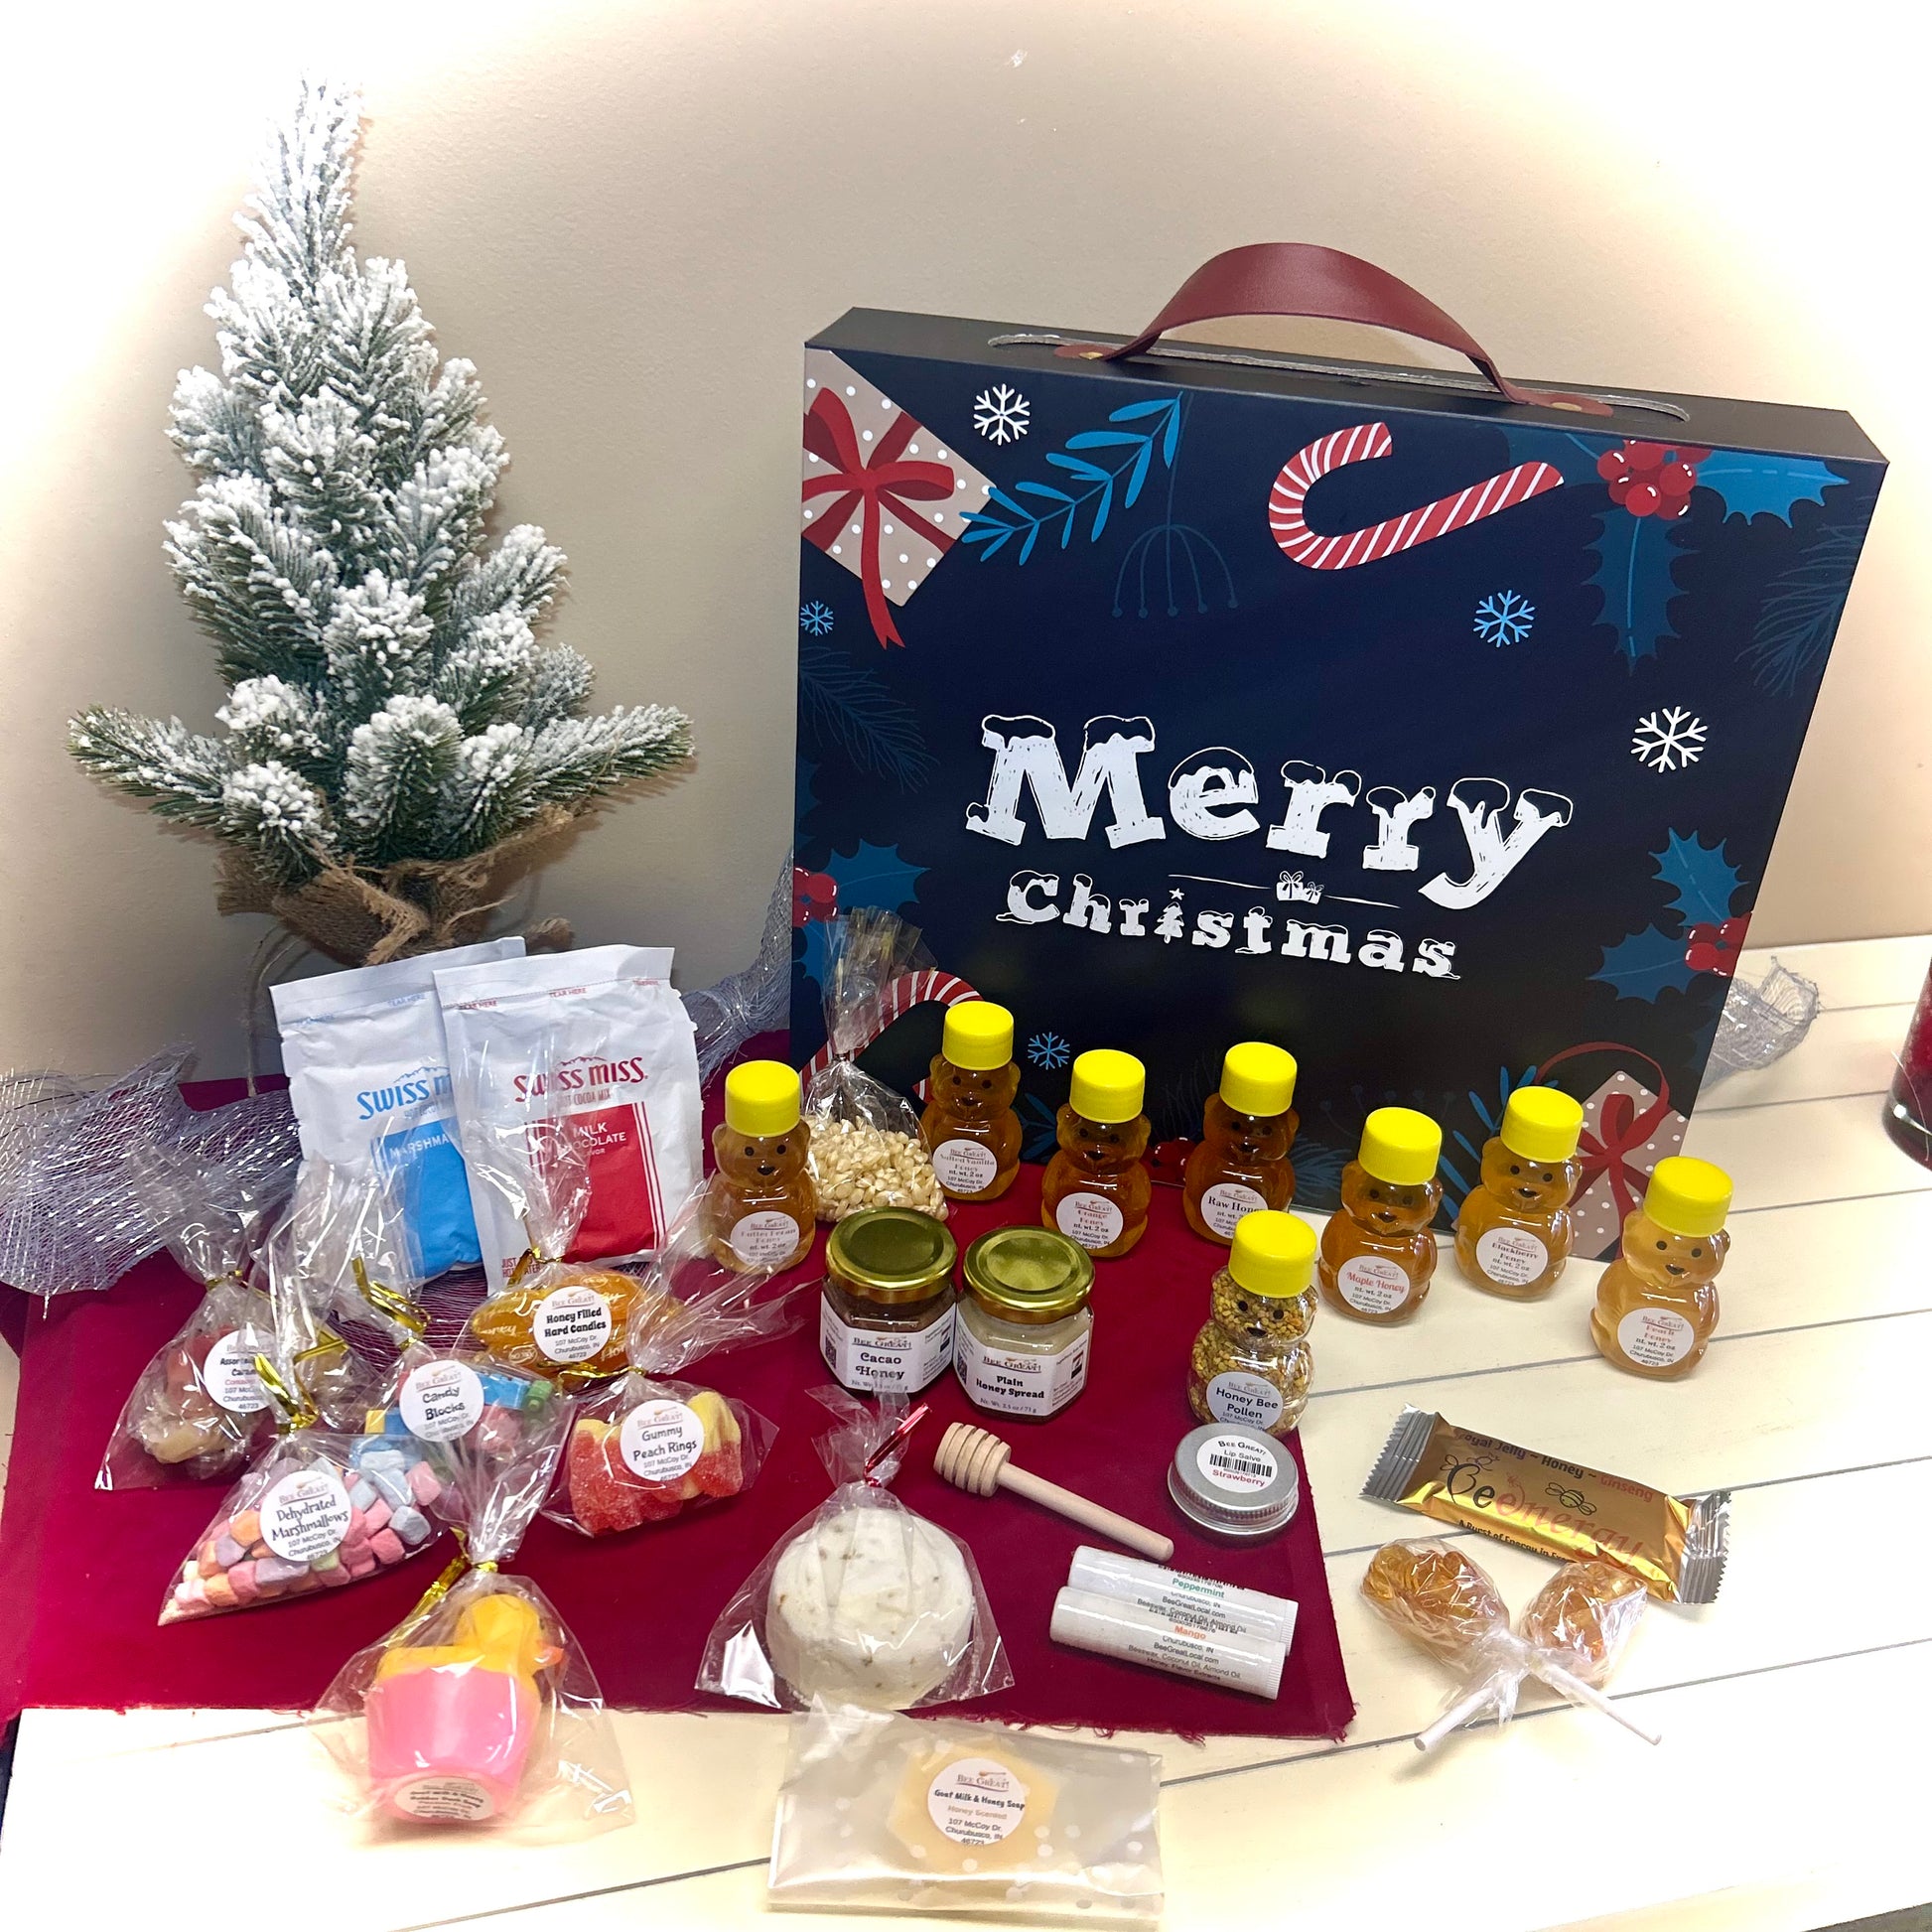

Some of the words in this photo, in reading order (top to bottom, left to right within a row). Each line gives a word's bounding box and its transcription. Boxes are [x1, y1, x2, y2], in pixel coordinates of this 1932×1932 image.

[966, 714, 1574, 910] Merry
[995, 870, 1460, 980] Christmas
[356, 1079, 431, 1120] SWISS
[573, 1122, 608, 1139] MILK
[388, 1133, 450, 1159] MARSHMA
[1207, 1195, 1230, 1208] Raw
[1346, 1271, 1375, 1287] Maple
[1375, 1279, 1406, 1294] Honey
[546, 1312, 576, 1324] Honey
[577, 1307, 602, 1319] Filled
[544, 1325, 569, 1337] Hard
[570, 1320, 607, 1333] Candies
[860, 1351, 902, 1365] Cacao
[855, 1365, 905, 1381] Honey
[996, 1375, 1024, 1387] Plain
[422, 1386, 461, 1404] Candy
[976, 1377, 1007, 1396] Honey
[1008, 1387, 1045, 1399] Spread
[1215, 1387, 1253, 1406] Honey
[1256, 1398, 1279, 1409] Bee
[425, 1402, 466, 1421] Blocks
[1226, 1403, 1263, 1420] Pollen
[641, 1426, 683, 1442] Gummy
[632, 1445, 666, 1461] Peach
[667, 1440, 698, 1453] Rings
[1238, 1451, 1262, 1462] Salve
[1212, 1469, 1266, 1487] Strawberry
[1495, 1440, 1528, 1460] Jelly
[1540, 1455, 1586, 1479] Honey
[1598, 1470, 1654, 1503] Ginseng
[276, 1494, 338, 1523] Dehydrated
[271, 1510, 349, 1542] Marshmallows
[1172, 1578, 1225, 1598] Peppermint
[1174, 1625, 1206, 1640] Mango
[934, 1789, 954, 1798] Goat
[954, 1792, 972, 1802] Milk
[981, 1795, 1005, 1809] Honey
[1007, 1799, 1026, 1811] Soap
[964, 1820, 991, 1831] McCoy
